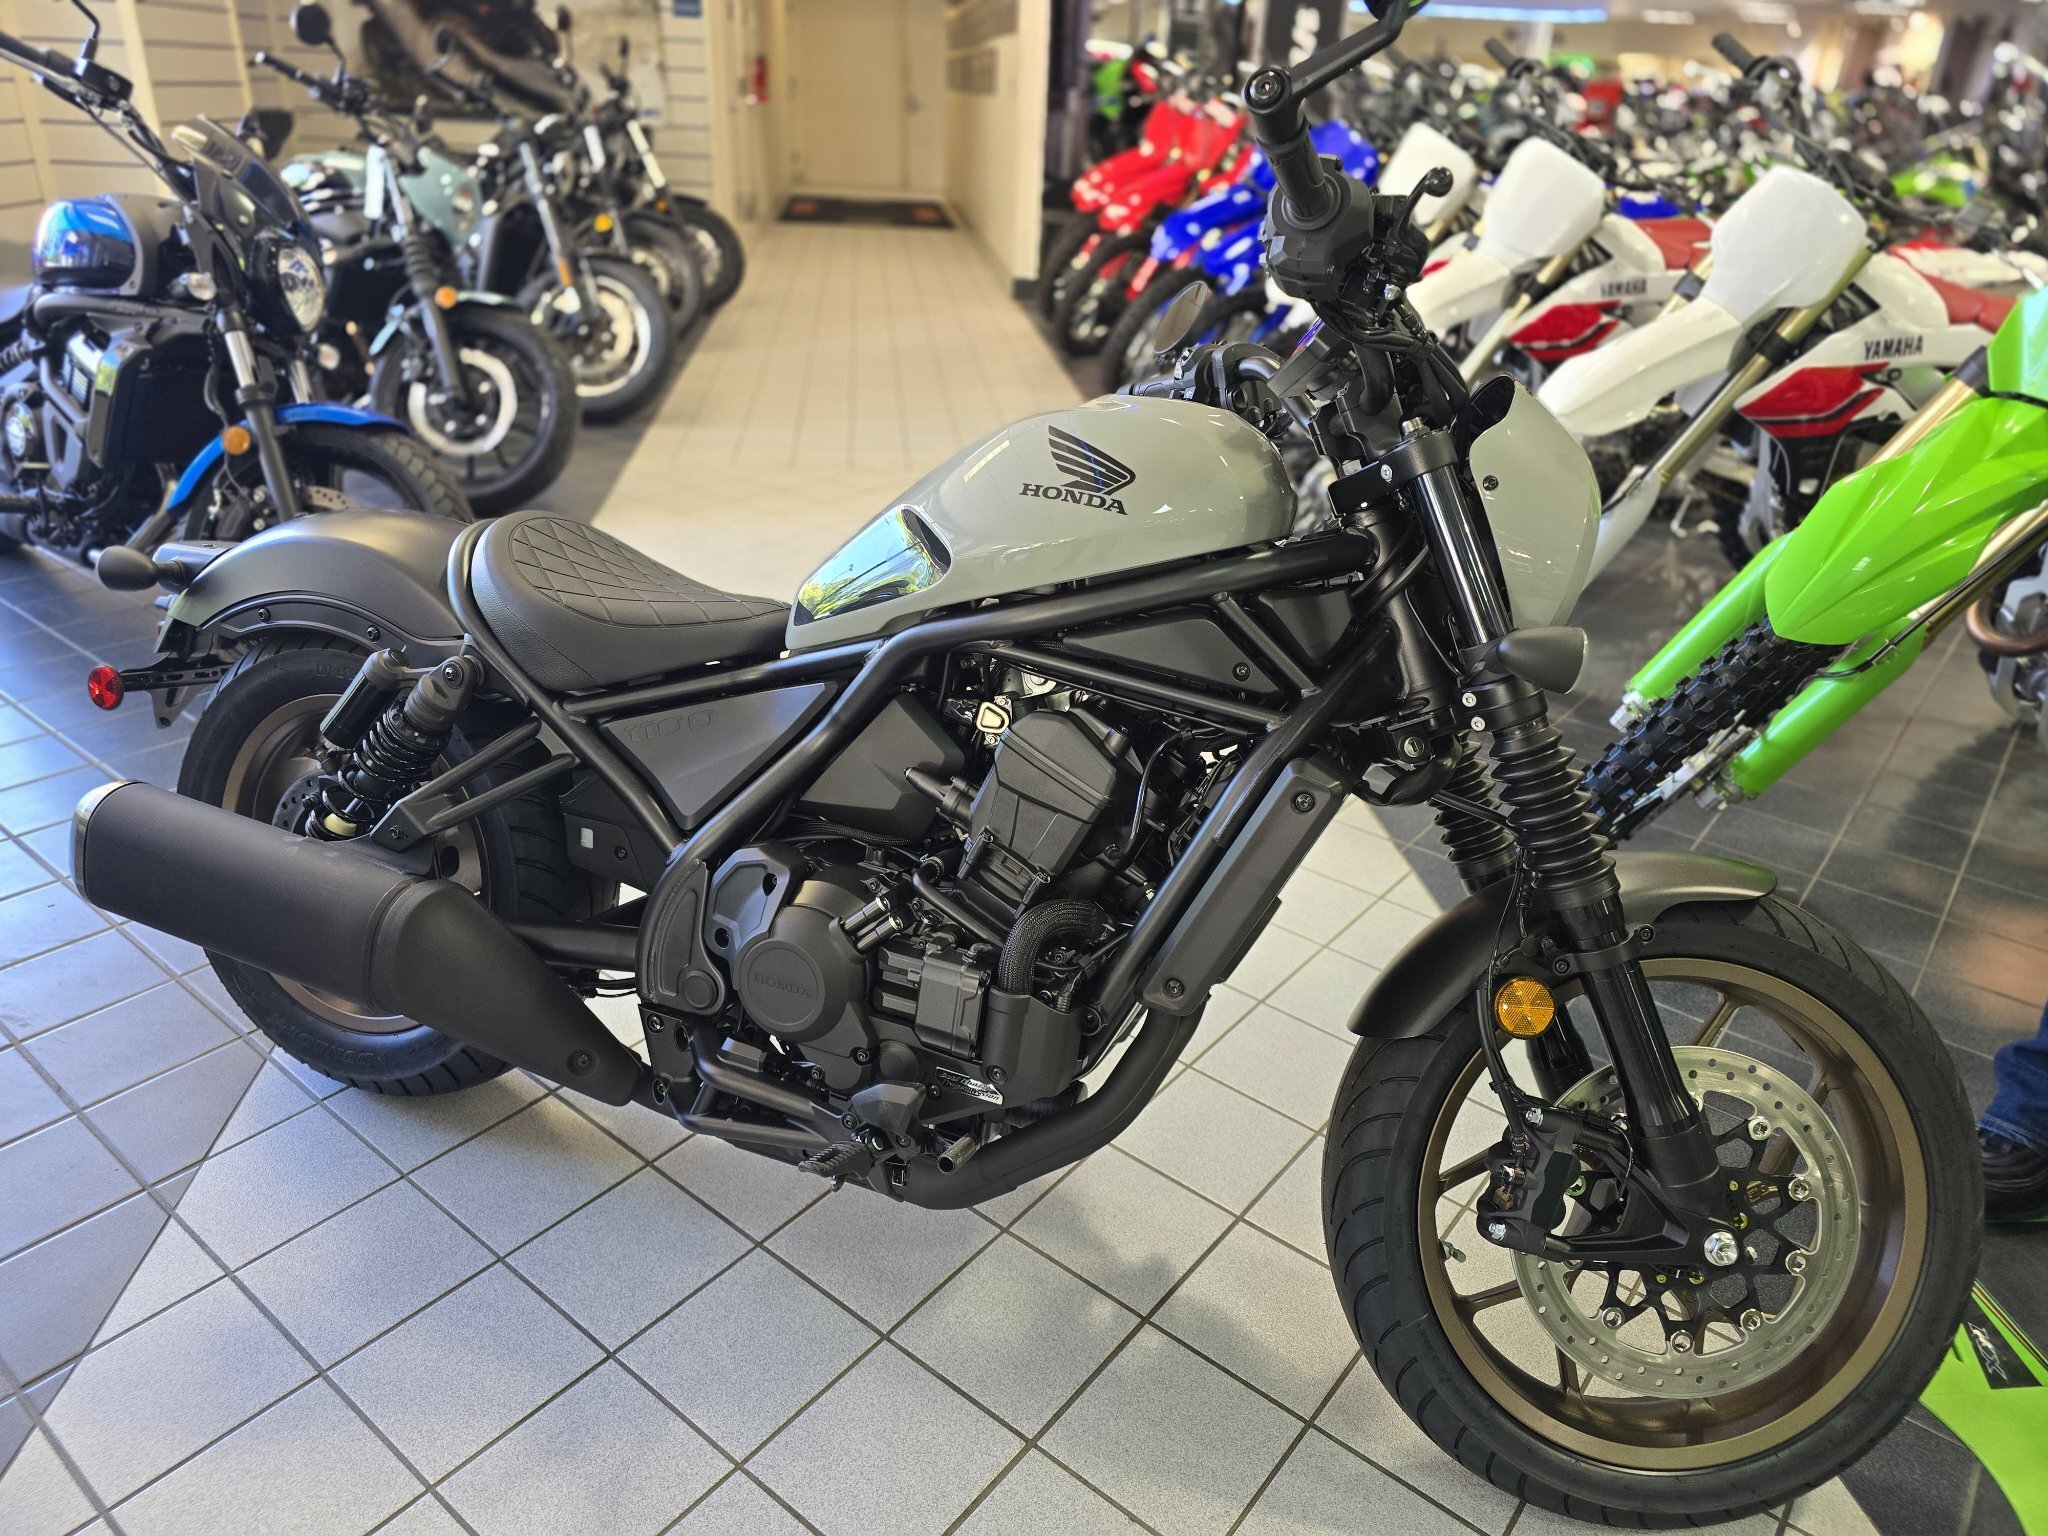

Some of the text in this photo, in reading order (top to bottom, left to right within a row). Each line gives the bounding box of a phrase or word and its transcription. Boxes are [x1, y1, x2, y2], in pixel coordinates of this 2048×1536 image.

[1600, 277, 1647, 298] YAMAHA
[1864, 334, 1924, 361] YAMAHA
[1019, 483, 1128, 516] HONDA
[623, 708, 717, 743] 1100
[753, 973, 813, 999] HONDA
[286, 1025, 376, 1066] DUNLOP
